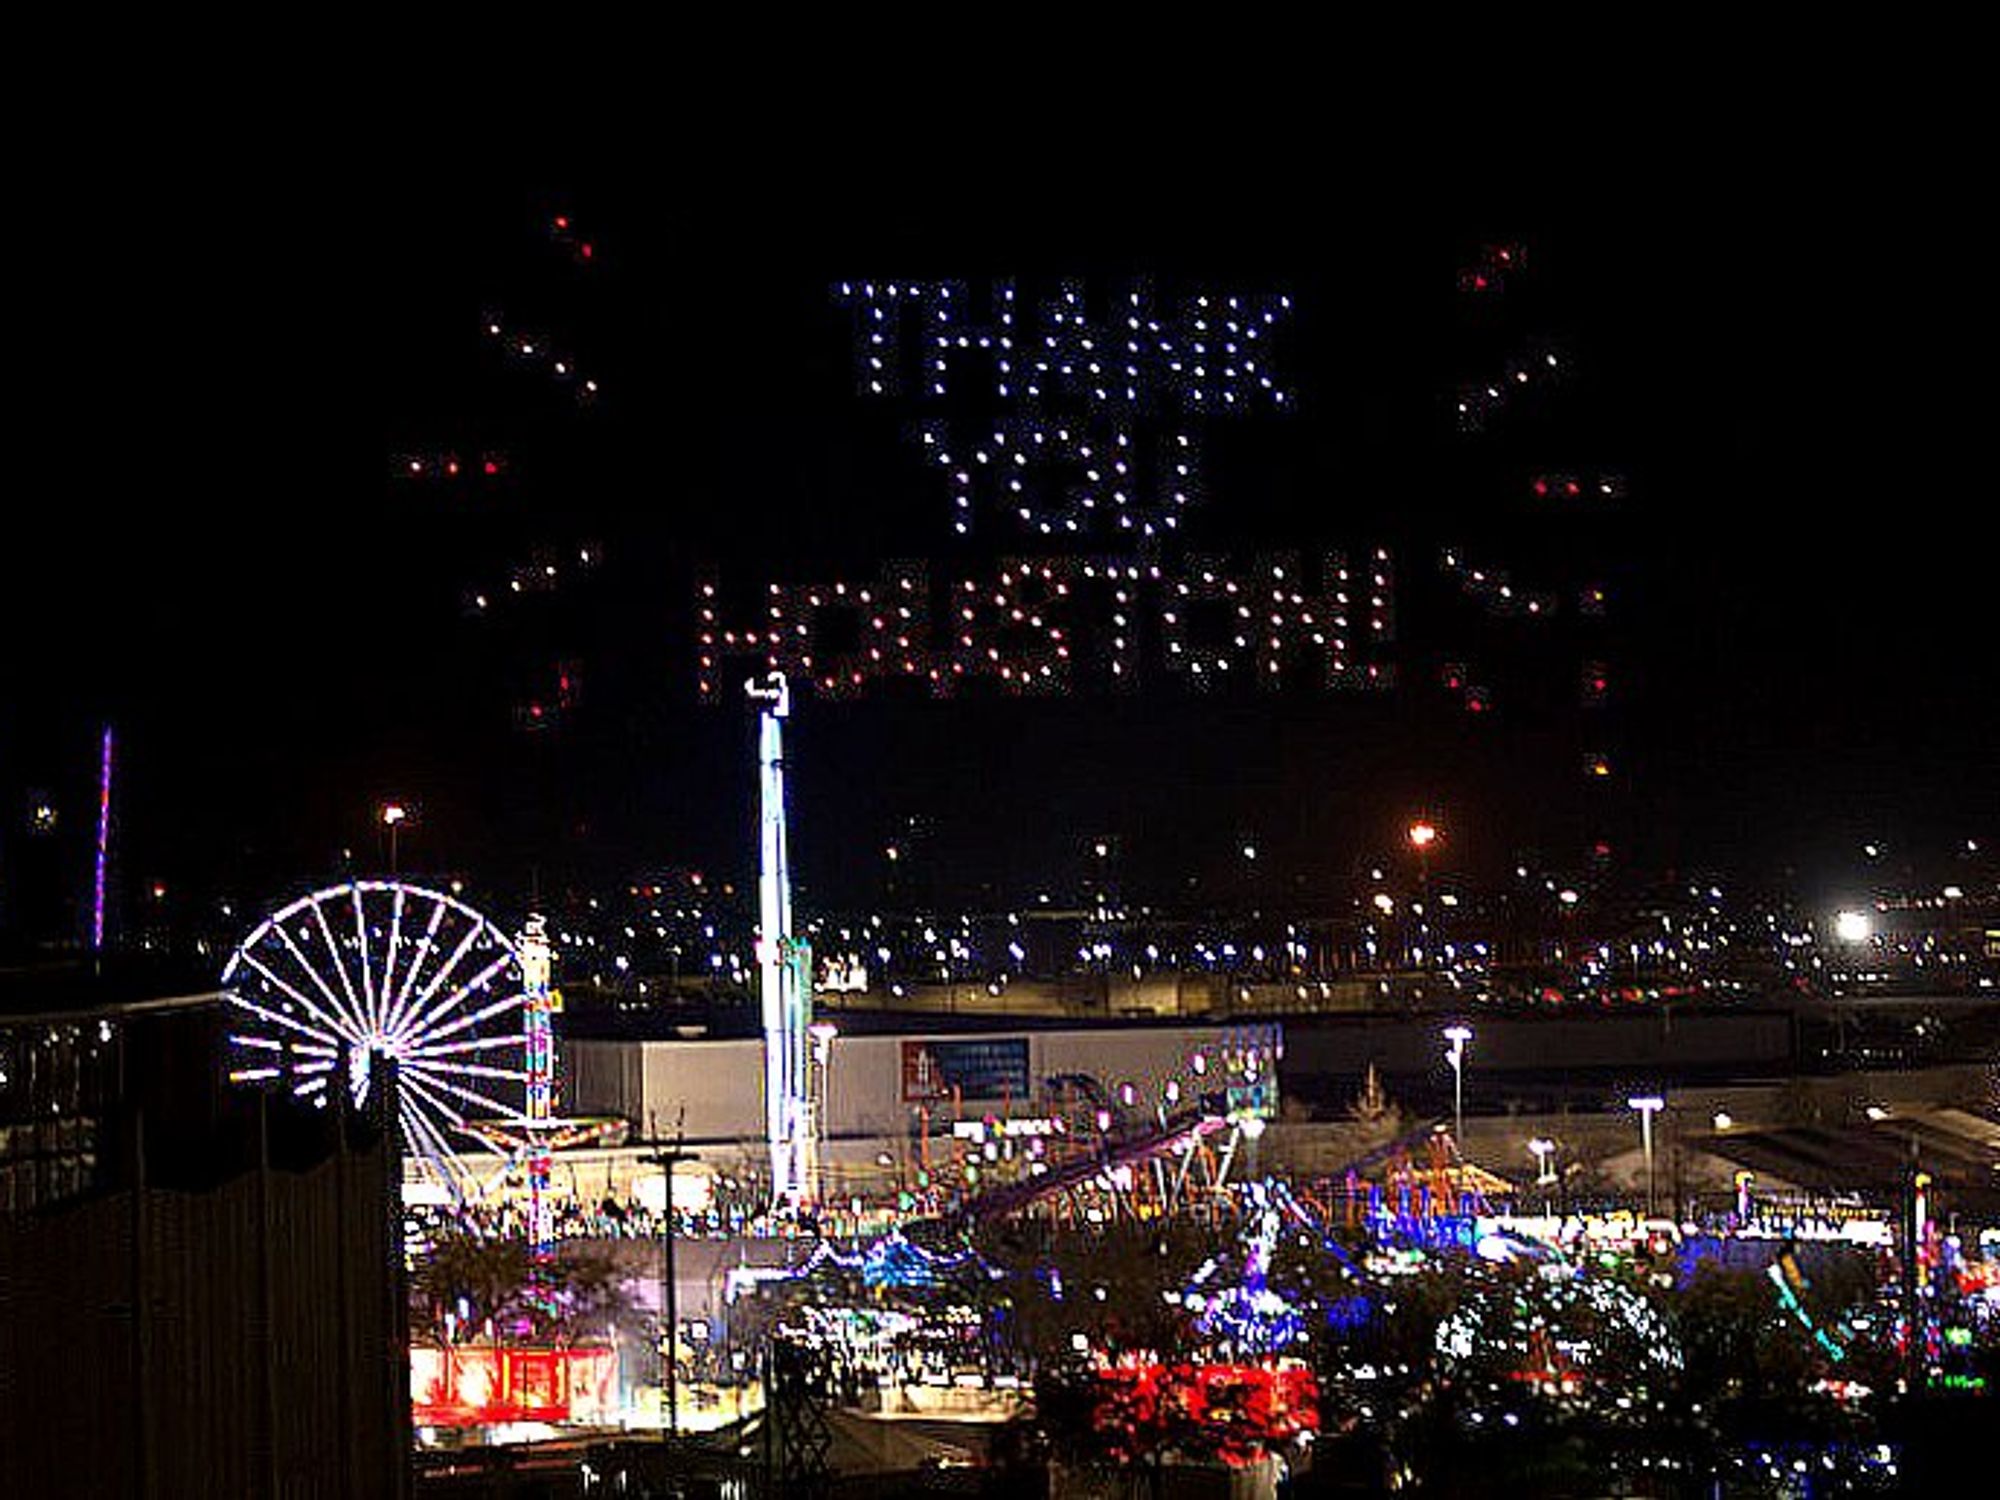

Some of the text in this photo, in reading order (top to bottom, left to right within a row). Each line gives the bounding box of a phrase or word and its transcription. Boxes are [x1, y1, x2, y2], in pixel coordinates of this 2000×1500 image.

[840, 282, 1291, 403] THANK
[923, 429, 1189, 536] YOU
[700, 548, 1388, 692] HOUSTON!
